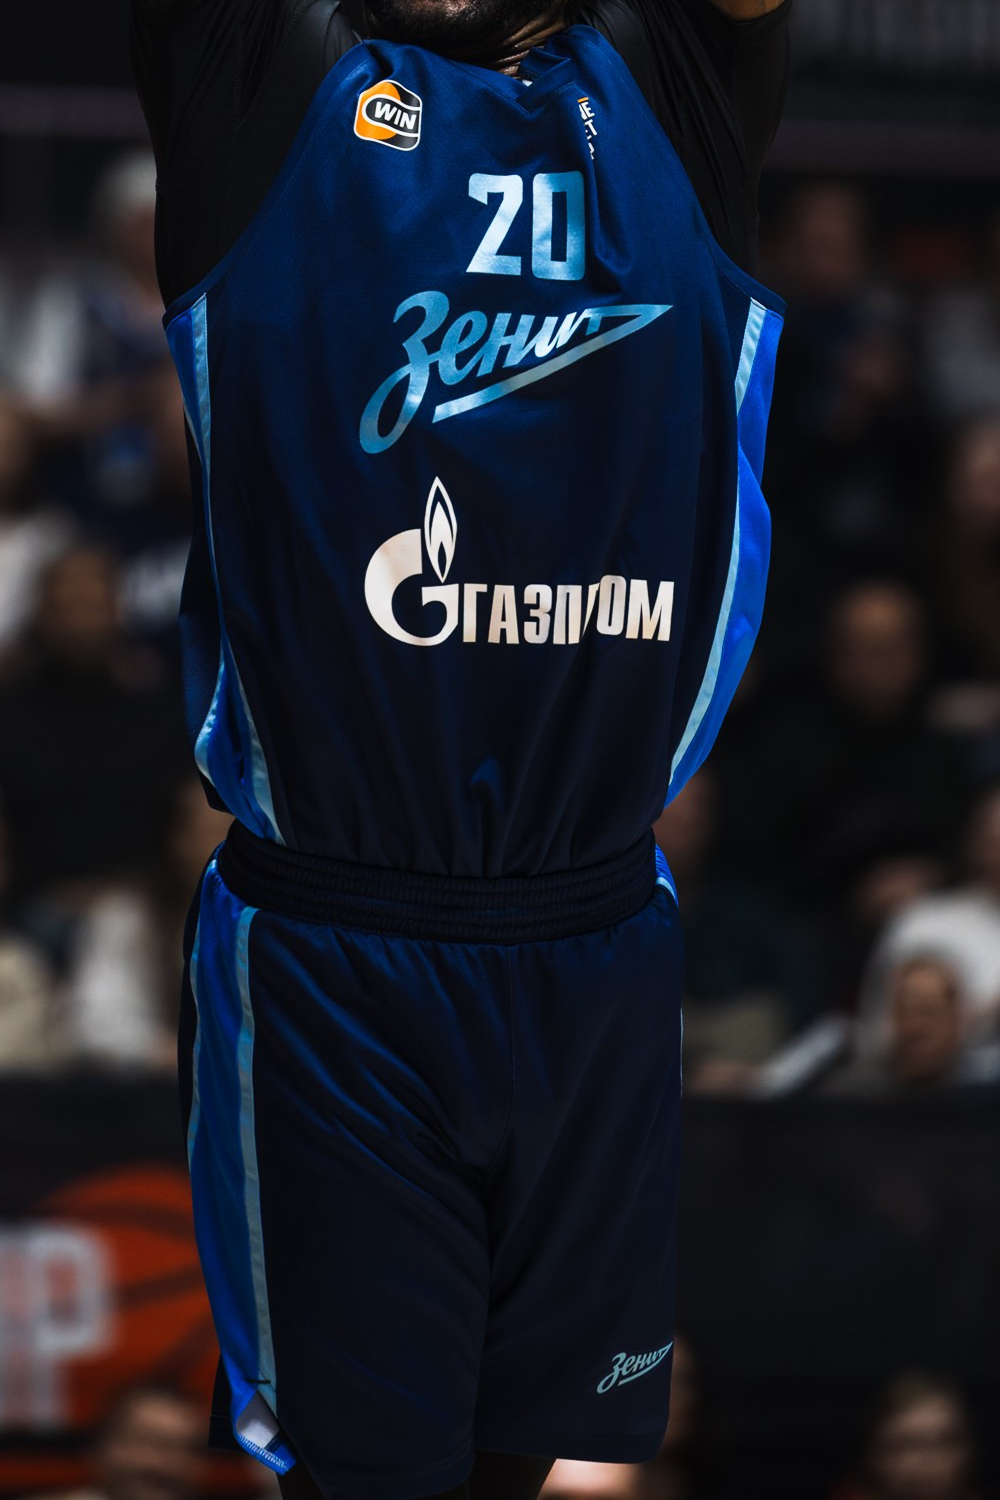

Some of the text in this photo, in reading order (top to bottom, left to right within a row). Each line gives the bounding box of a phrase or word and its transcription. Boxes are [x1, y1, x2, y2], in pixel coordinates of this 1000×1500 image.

[374, 101, 417, 130] WIN
[466, 170, 586, 281] 20
[597, 1341, 673, 1394] Зенит
